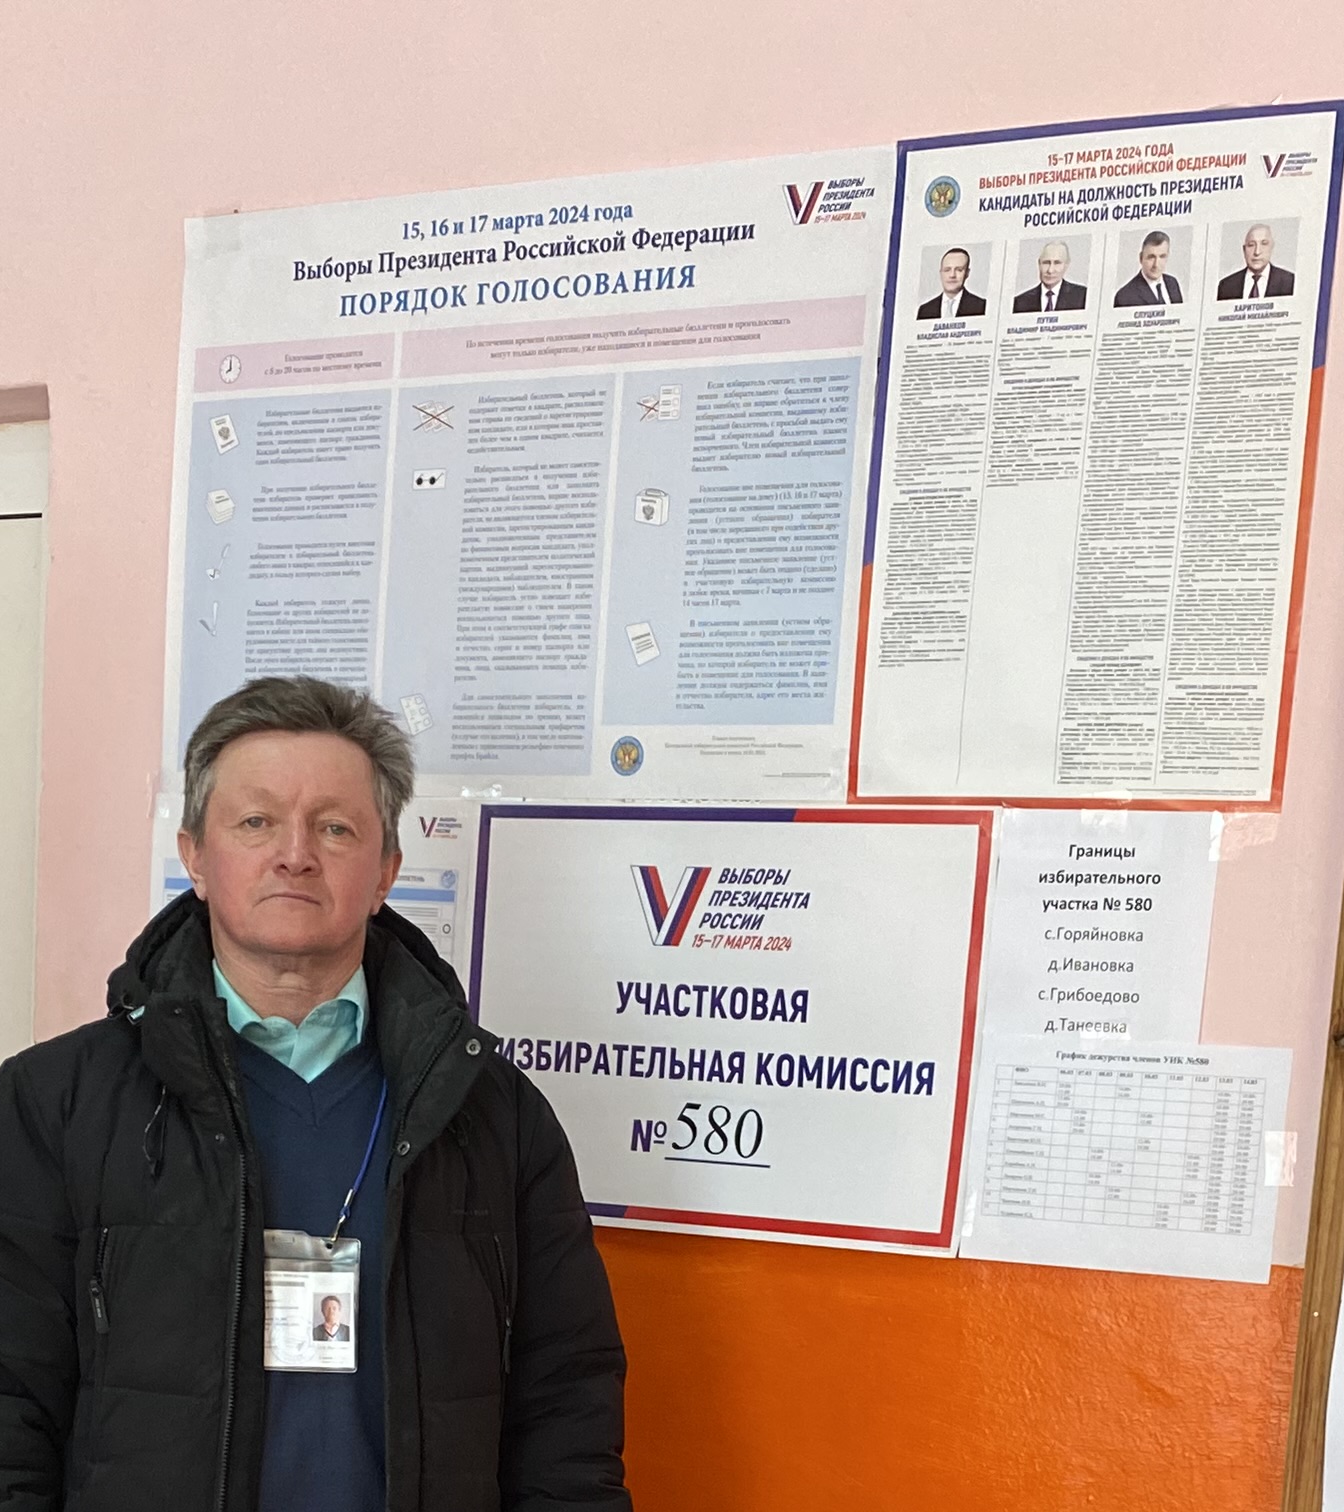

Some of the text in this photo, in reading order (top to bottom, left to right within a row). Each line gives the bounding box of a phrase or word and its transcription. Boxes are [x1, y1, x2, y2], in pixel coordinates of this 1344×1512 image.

[1047, 142, 1174, 167] 15-17 МАРТА 2024 ГОДА
[978, 173, 1027, 190] ВЫБОРЫ
[1028, 166, 1098, 186] ПРЕЗИДЕНТА
[1099, 156, 1174, 179] РОССИЙСКОЙ
[1175, 152, 1247, 172] ФЕДЕРАЦИИ
[827, 177, 865, 190] ВЫБОРЫ
[822, 188, 875, 201] ПРЕЗИДЕНТА
[978, 174, 1244, 213] КАНДИДАТЫ НА ДОЛЖНОСТЬ ПРЕЗИДЕНТА
[817, 202, 852, 213] РОССИИ
[1023, 199, 1193, 228] РОССИЙСКОЙ ФЕДЕРАЦИИ
[402, 204, 634, 242] 15, 16 и 17 марта 2024 года
[292, 223, 756, 283] Выборы Президента Российской Федерации
[339, 264, 696, 318] ПОРЯДОК ГОЛОСОВАНИЯ
[1069, 844, 1135, 861] Границы
[717, 867, 791, 886] ВЫБОРЫ
[1039, 869, 1161, 887] избирательного
[708, 890, 811, 910] ПРЕЗИДЕНТА
[1042, 897, 1152, 912] участка № 580
[699, 912, 765, 931] РОССИИ
[724, 935, 763, 951] МАРТА
[762, 936, 792, 952] 2024
[1047, 957, 1134, 973] д.Ивановка
[616, 980, 809, 1024] УЧАСТКОВАЯ
[1038, 987, 1140, 1004] с.Грибоедово
[498, 1037, 935, 1095] ИЗБИРАТЕЛЬНАЯ КОМИССИЯ
